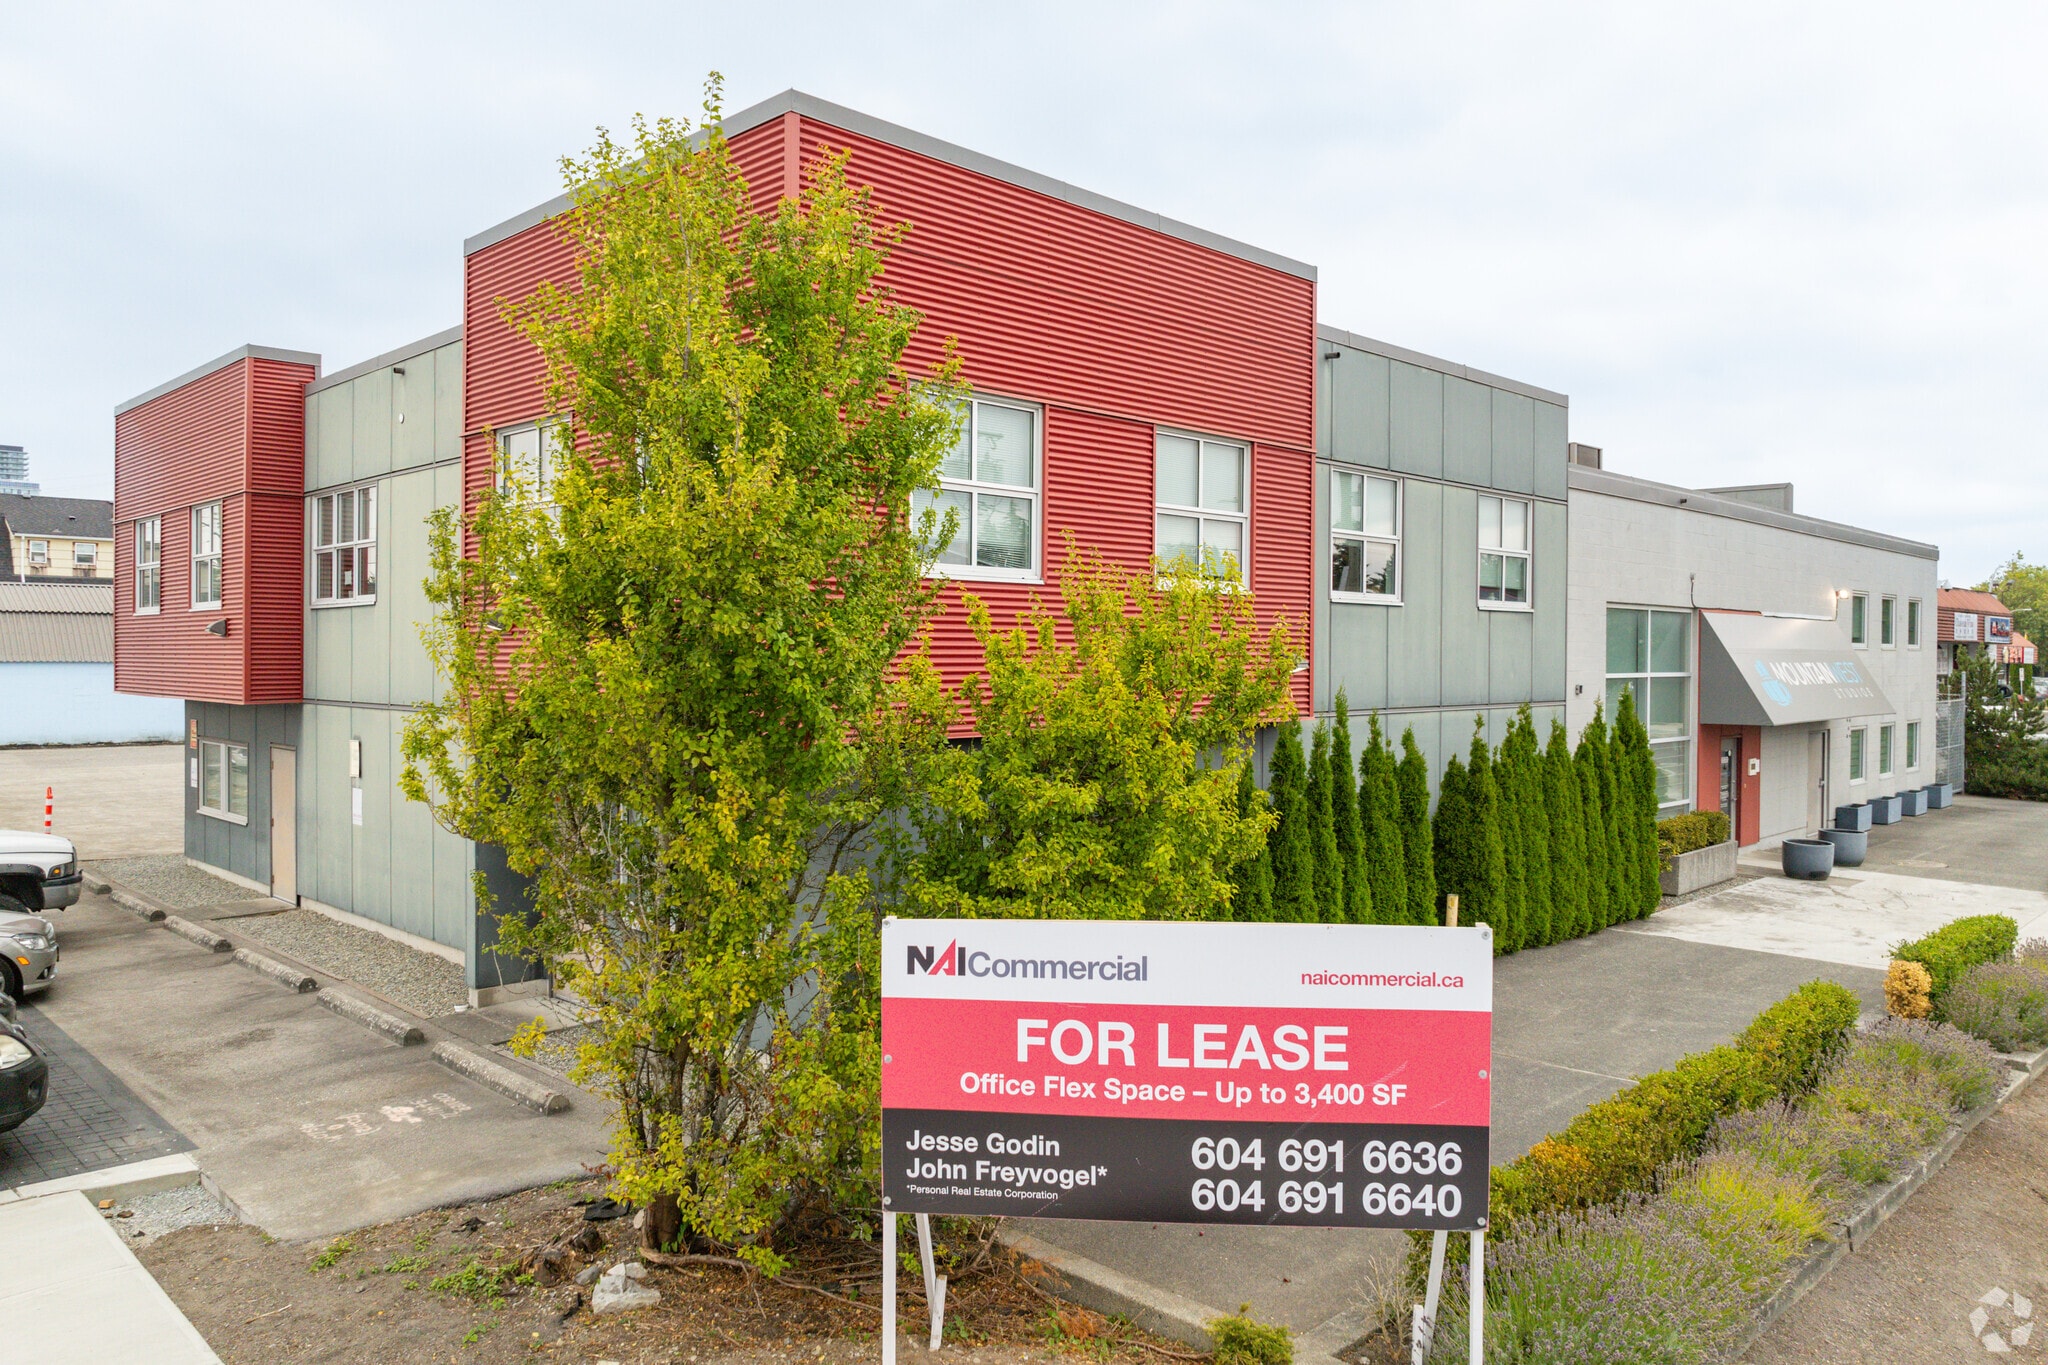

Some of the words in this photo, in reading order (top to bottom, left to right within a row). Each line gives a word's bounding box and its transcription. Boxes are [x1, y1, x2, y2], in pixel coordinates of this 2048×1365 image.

[1301, 970, 1464, 988] naicommercial.ca
[1016, 1018, 1136, 1067] FOR
[1158, 1023, 1349, 1071] LEASE
[960, 1072, 1036, 1097] Office
[1044, 1075, 1097, 1099] Flex
[1103, 1078, 1186, 1104] Space
[1216, 1081, 1253, 1107] Up
[1260, 1083, 1286, 1103] to
[1294, 1083, 1365, 1107] 3,400
[1372, 1084, 1407, 1106] SF
[906, 1130, 978, 1152] Jesse
[986, 1132, 1060, 1156] Godin
[1191, 1137, 1265, 1171] 604
[1278, 1139, 1343, 1173] 691
[1362, 1140, 1462, 1175] 6636
[906, 1157, 967, 1180] John
[951, 1186, 972, 1196] Real
[974, 1187, 1002, 1197] Estate
[1004, 1189, 1058, 1200] Corporation
[1191, 1178, 1265, 1212] 604
[1278, 1181, 1343, 1214] 691
[1362, 1182, 1462, 1218] 6640
